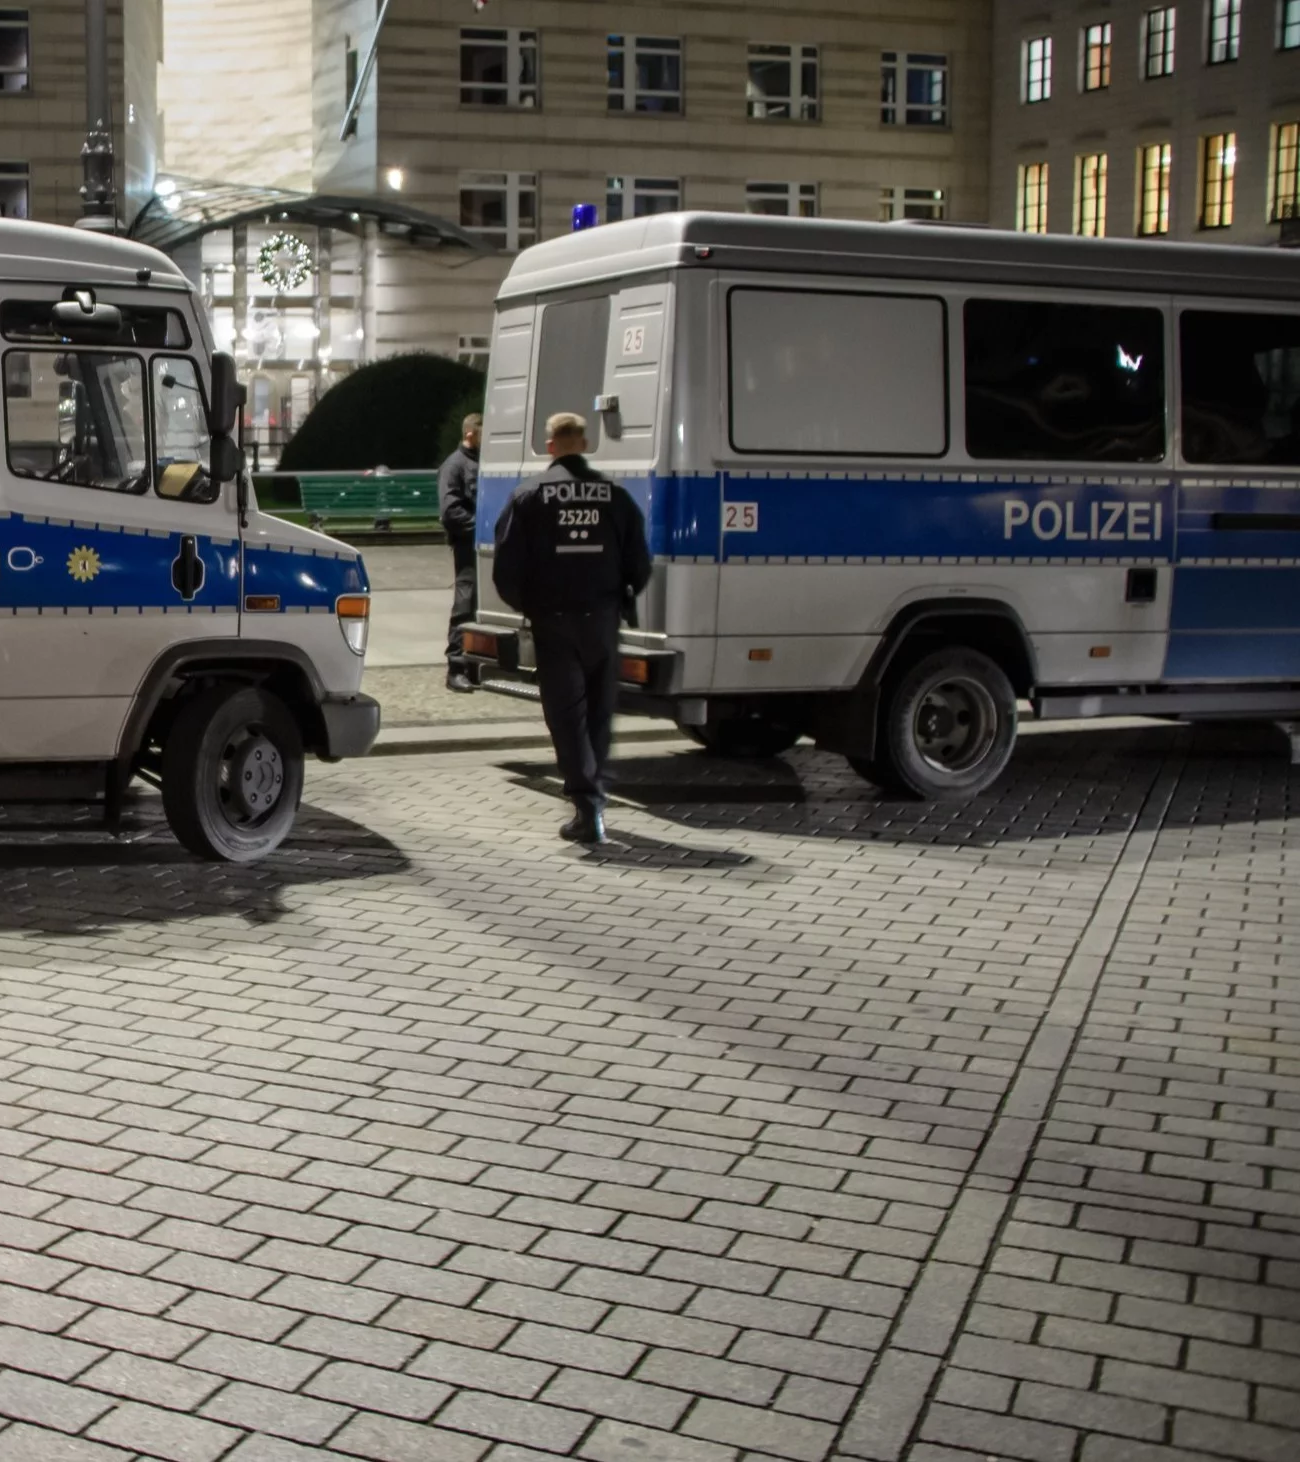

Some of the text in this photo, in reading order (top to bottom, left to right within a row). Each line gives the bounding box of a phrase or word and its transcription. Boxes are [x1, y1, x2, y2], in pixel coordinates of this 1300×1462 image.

[624, 329, 643, 352] 25
[543, 482, 611, 504] POLIZEI
[558, 509, 599, 525] 25220
[726, 506, 755, 527] 25
[1004, 500, 1162, 540] POLIZEI
